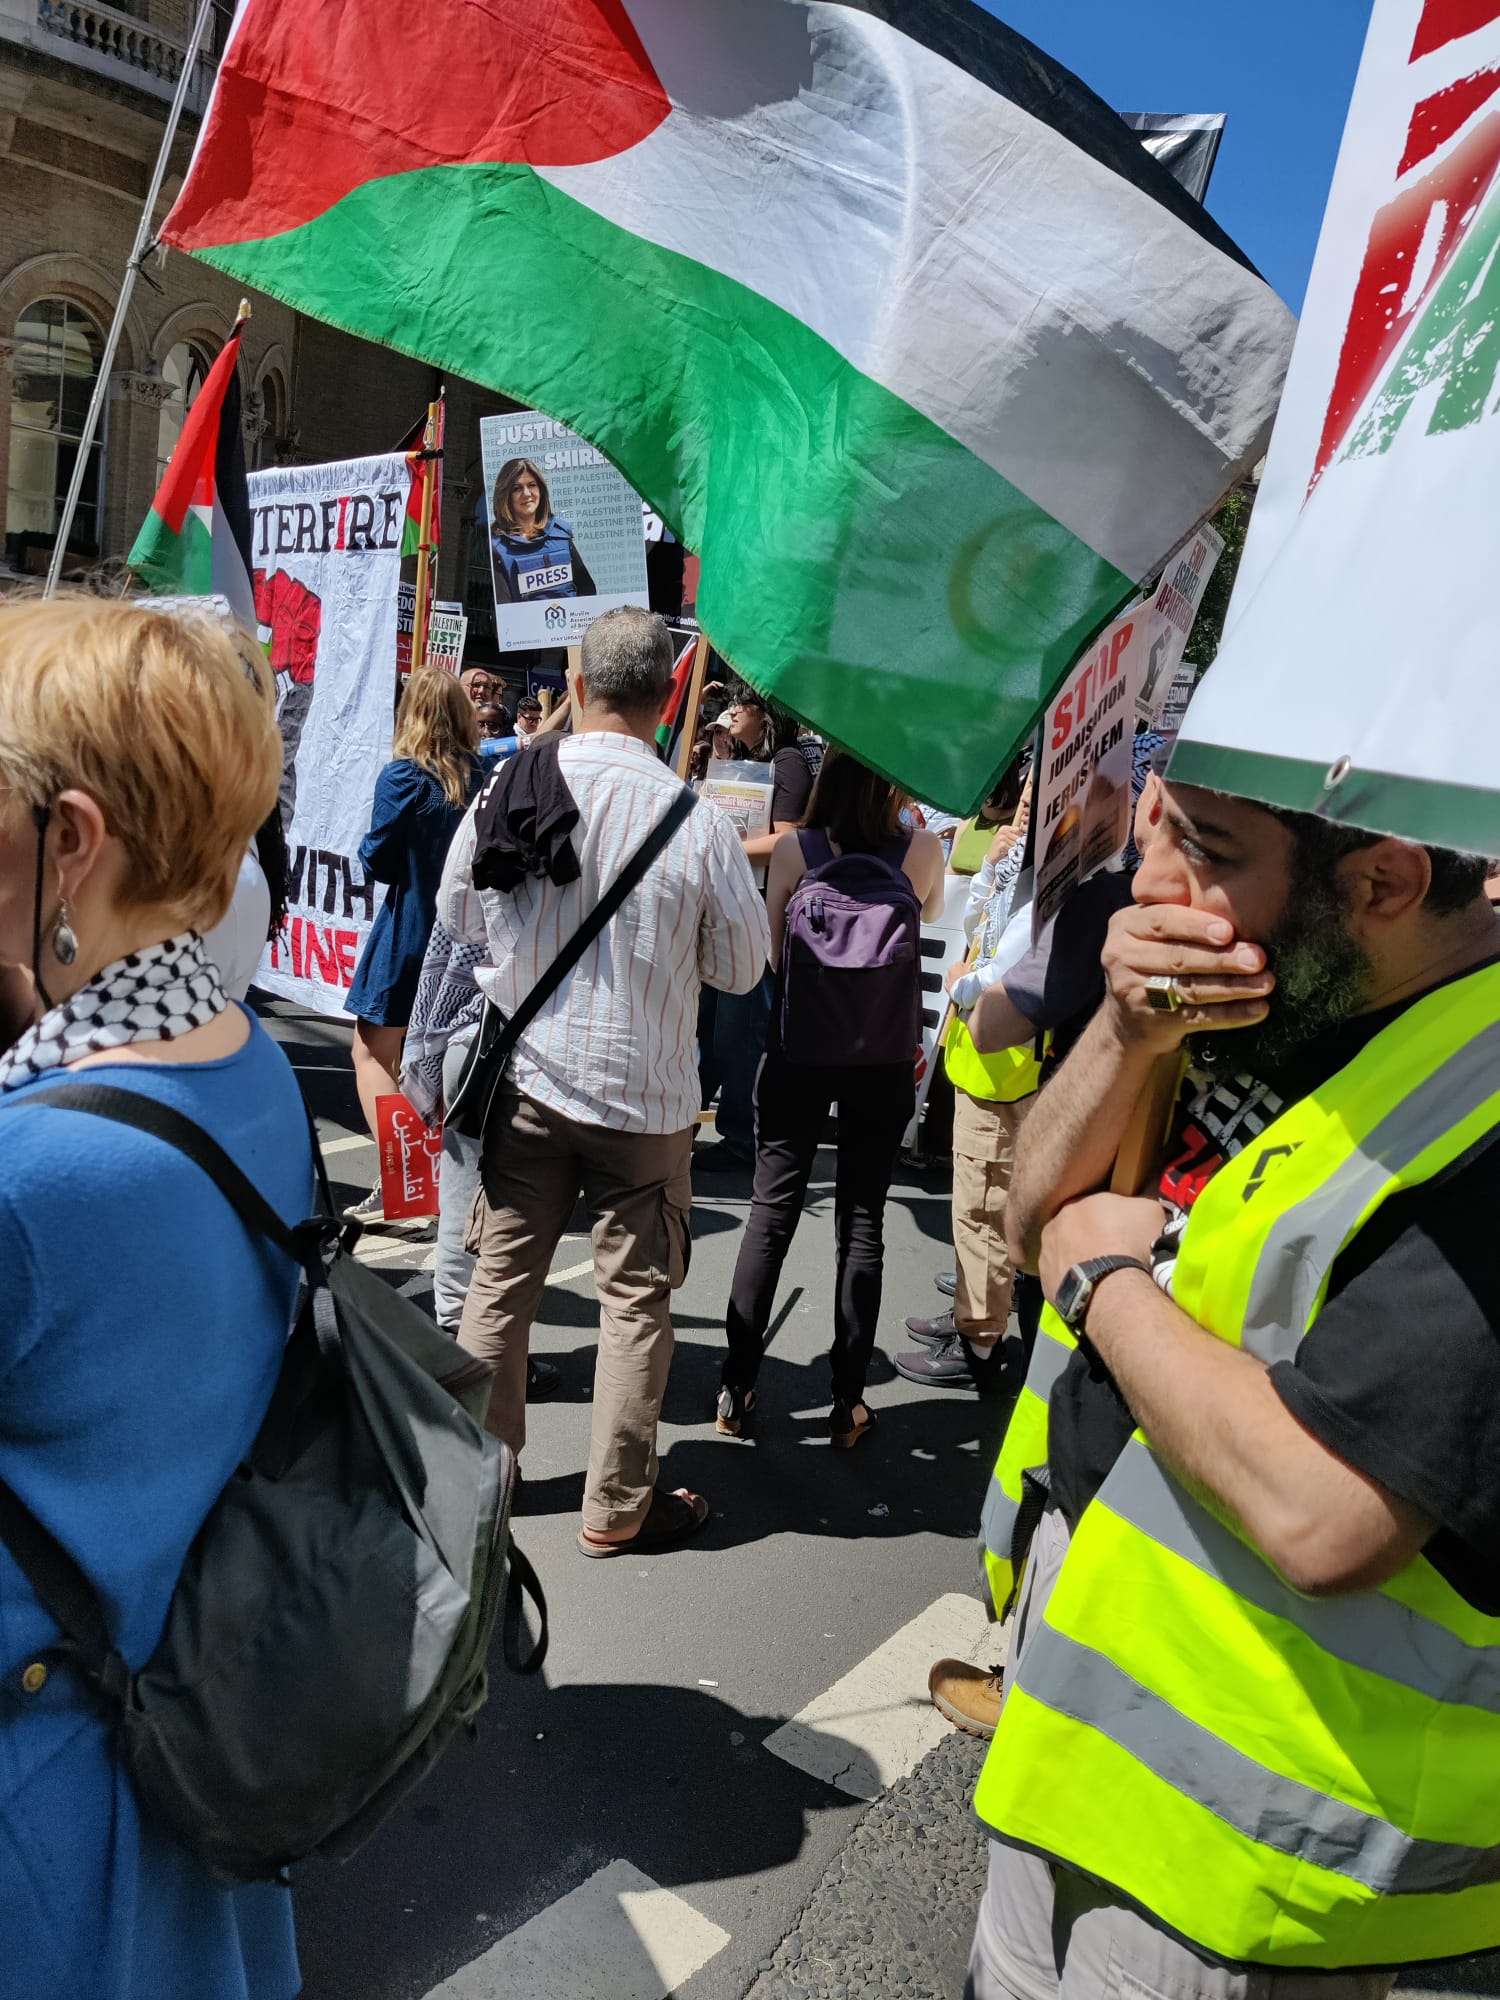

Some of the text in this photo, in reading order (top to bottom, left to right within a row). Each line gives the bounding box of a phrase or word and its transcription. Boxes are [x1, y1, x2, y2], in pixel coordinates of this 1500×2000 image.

[549, 441, 568, 451] FREE
[544, 448, 612, 470] SHIRE
[551, 471, 621, 486] FREE PALESTINE
[552, 487, 572, 497] FREE
[574, 483, 621, 495] PALESTINE
[553, 493, 641, 509] FREE PALESTINE FRE
[576, 506, 623, 518] PALESTINE
[625, 504, 642, 513] FRE
[577, 515, 643, 529] PALESTINE FRE
[578, 527, 643, 541] PALESTINE FRE
[525, 566, 569, 589] PRESS
[1171, 560, 1201, 605] ISRAELI
[428, 642, 460, 657] SIST!
[1051, 622, 1134, 750] STOP
